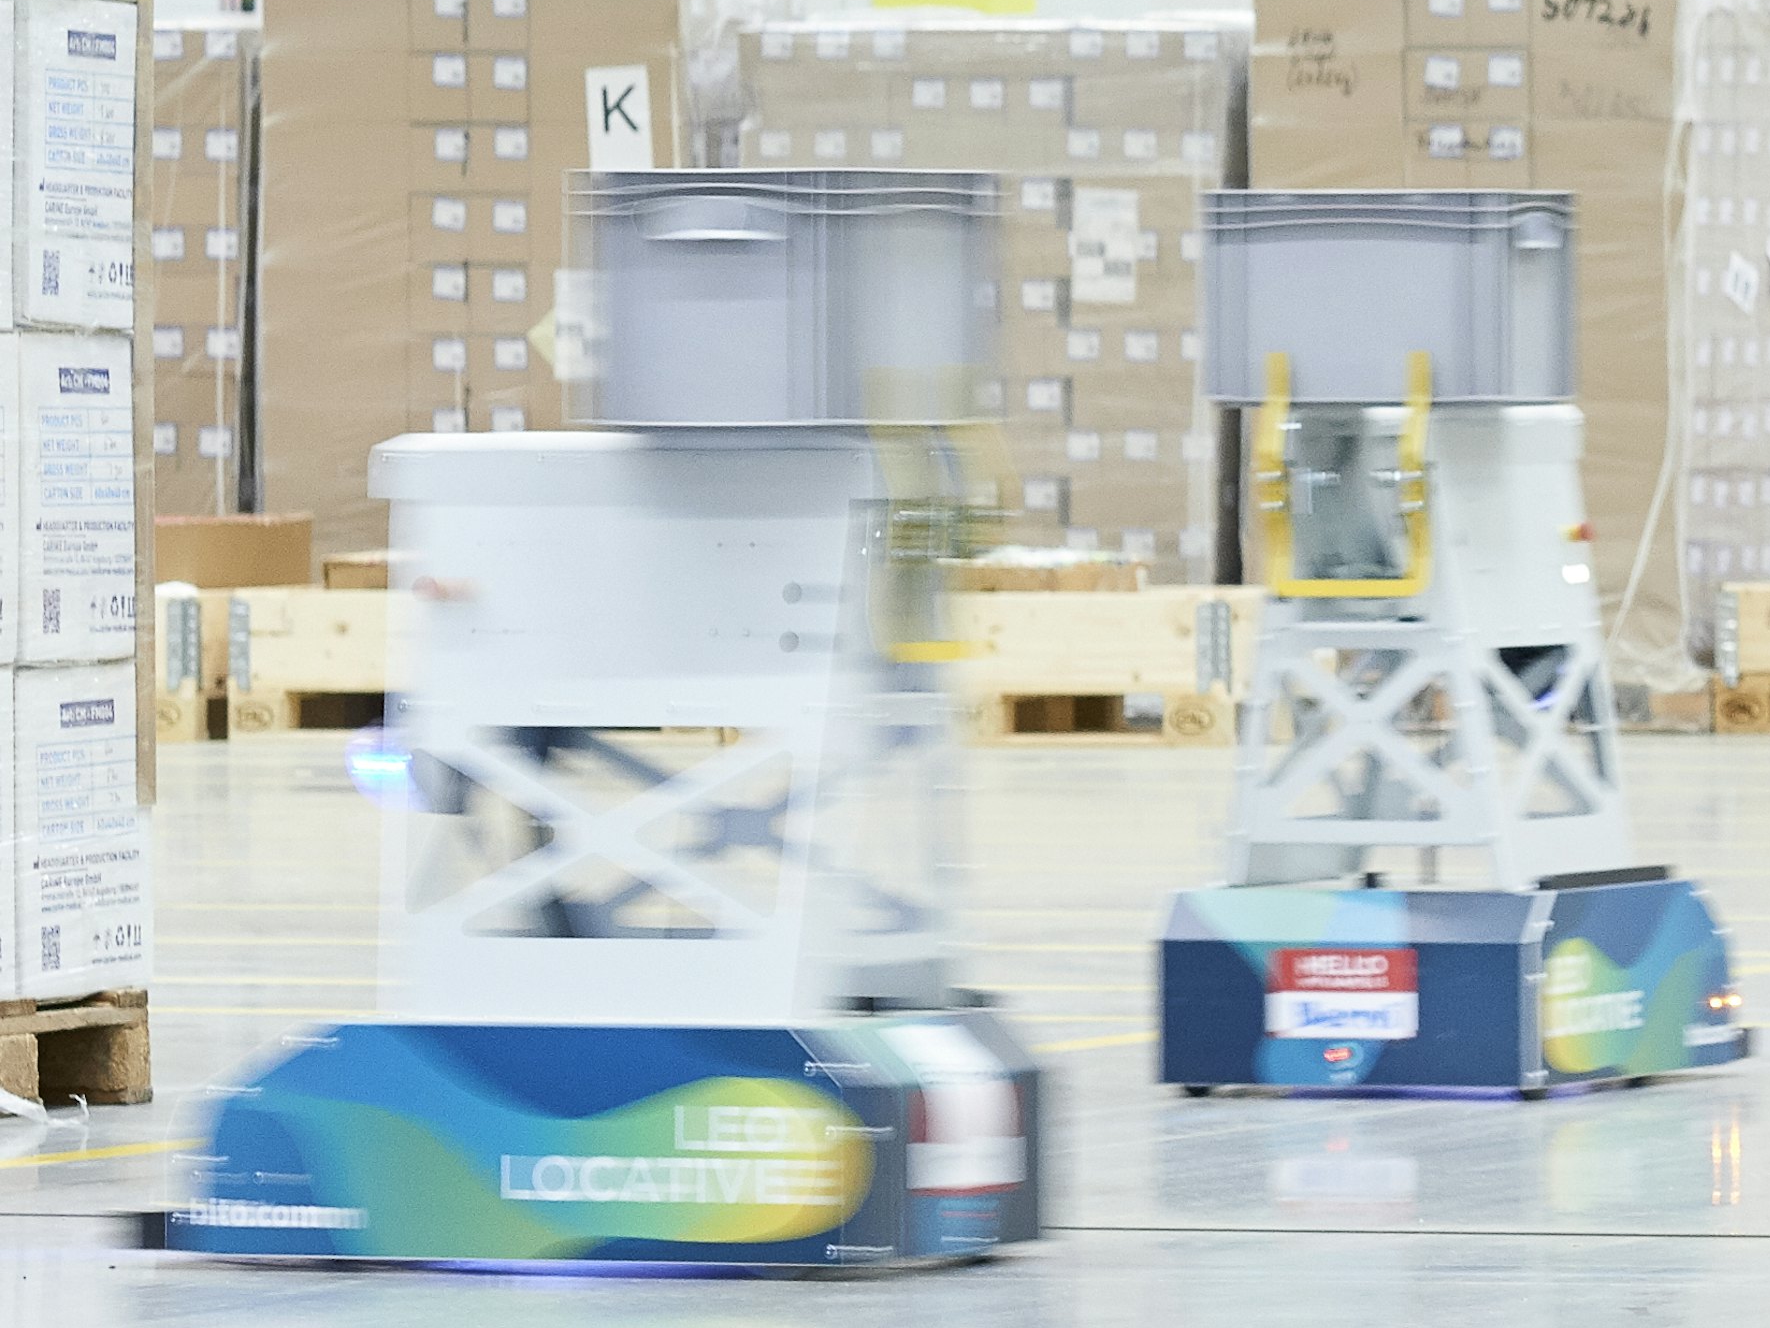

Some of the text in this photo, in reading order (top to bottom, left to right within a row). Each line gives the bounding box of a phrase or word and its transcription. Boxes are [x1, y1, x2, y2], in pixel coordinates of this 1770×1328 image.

[601, 84, 639, 134] K
[675, 1105, 795, 1151] LEO
[500, 1154, 835, 1205] LOCATIVE
